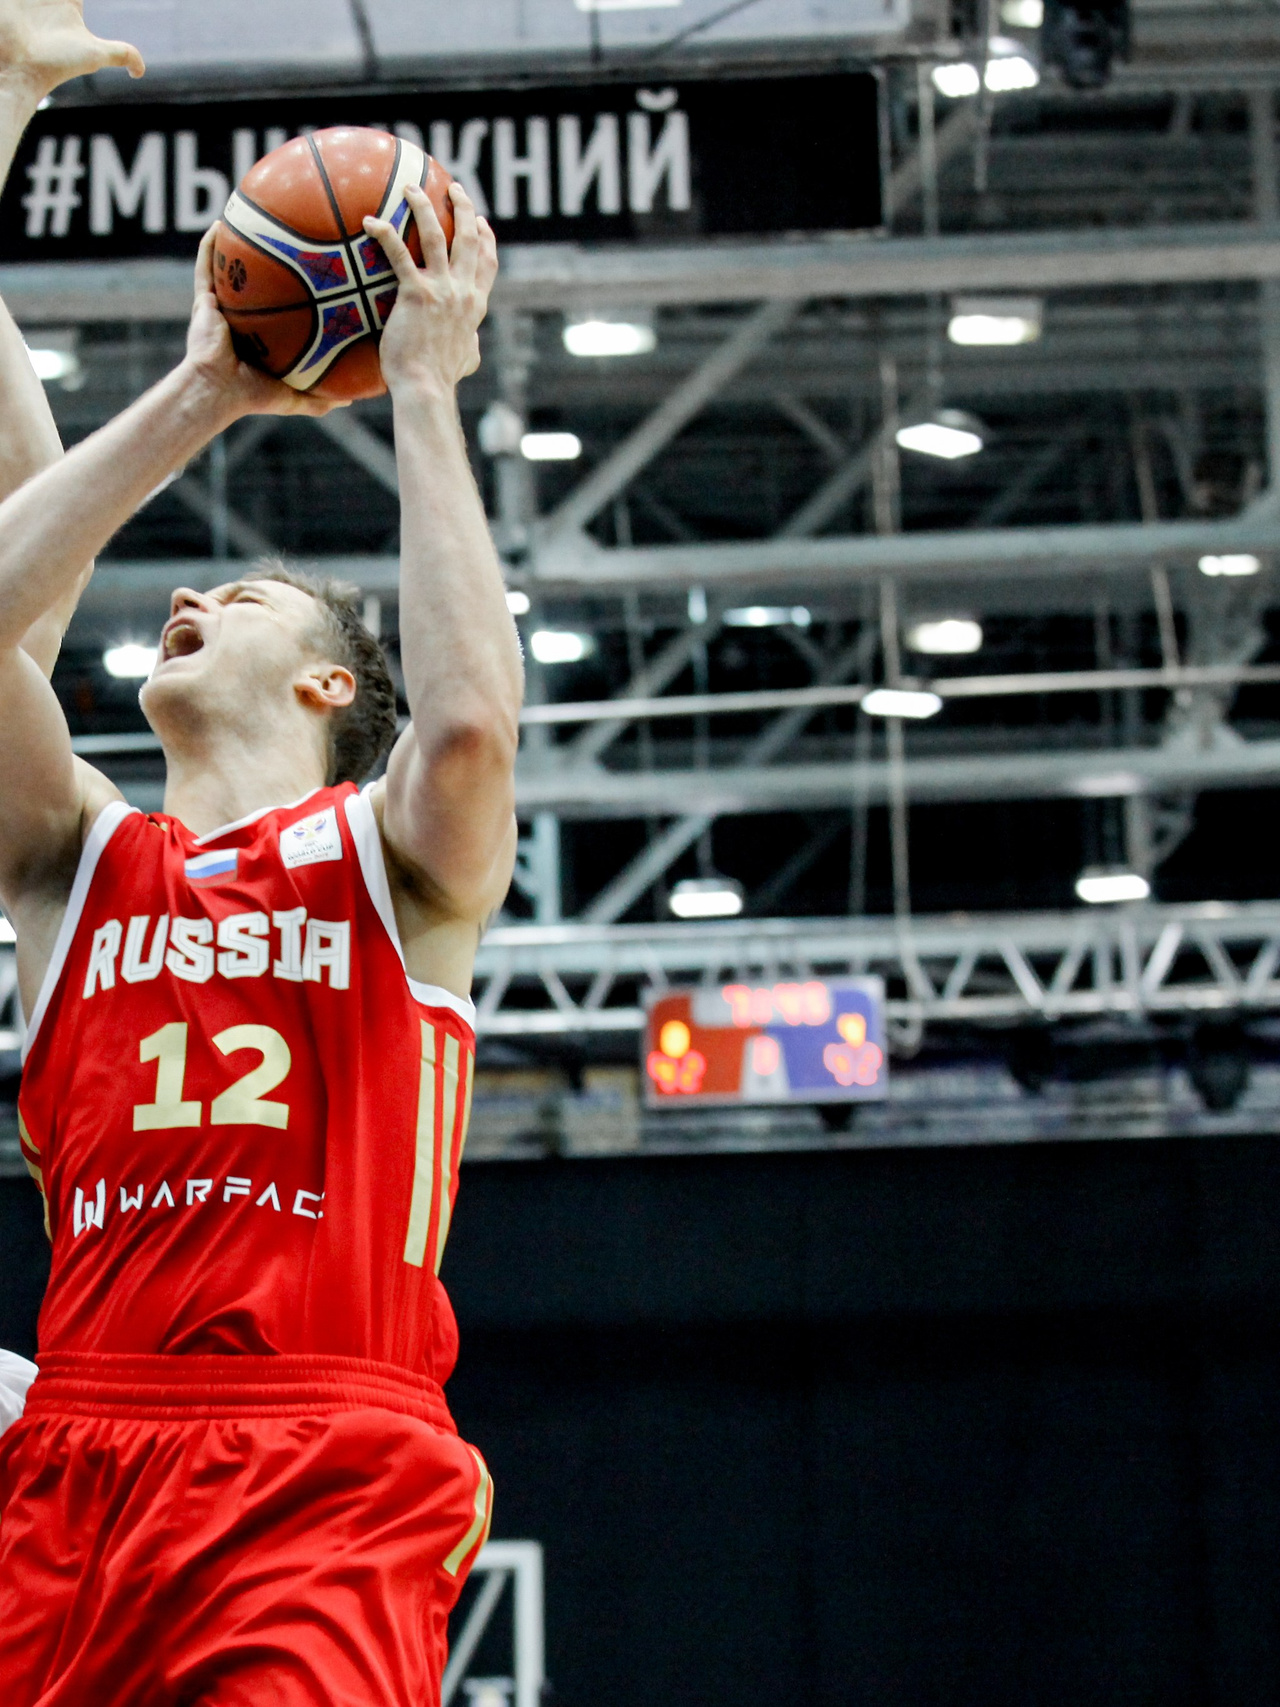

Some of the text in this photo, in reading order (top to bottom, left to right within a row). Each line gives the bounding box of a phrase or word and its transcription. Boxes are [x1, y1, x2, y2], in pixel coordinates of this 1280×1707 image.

[21, 88, 692, 237] #МЫЖНИЙ
[82, 906, 351, 999] RUSSIA
[132, 1021, 292, 1132] 12
[120, 1175, 326, 1221] WARFAC
